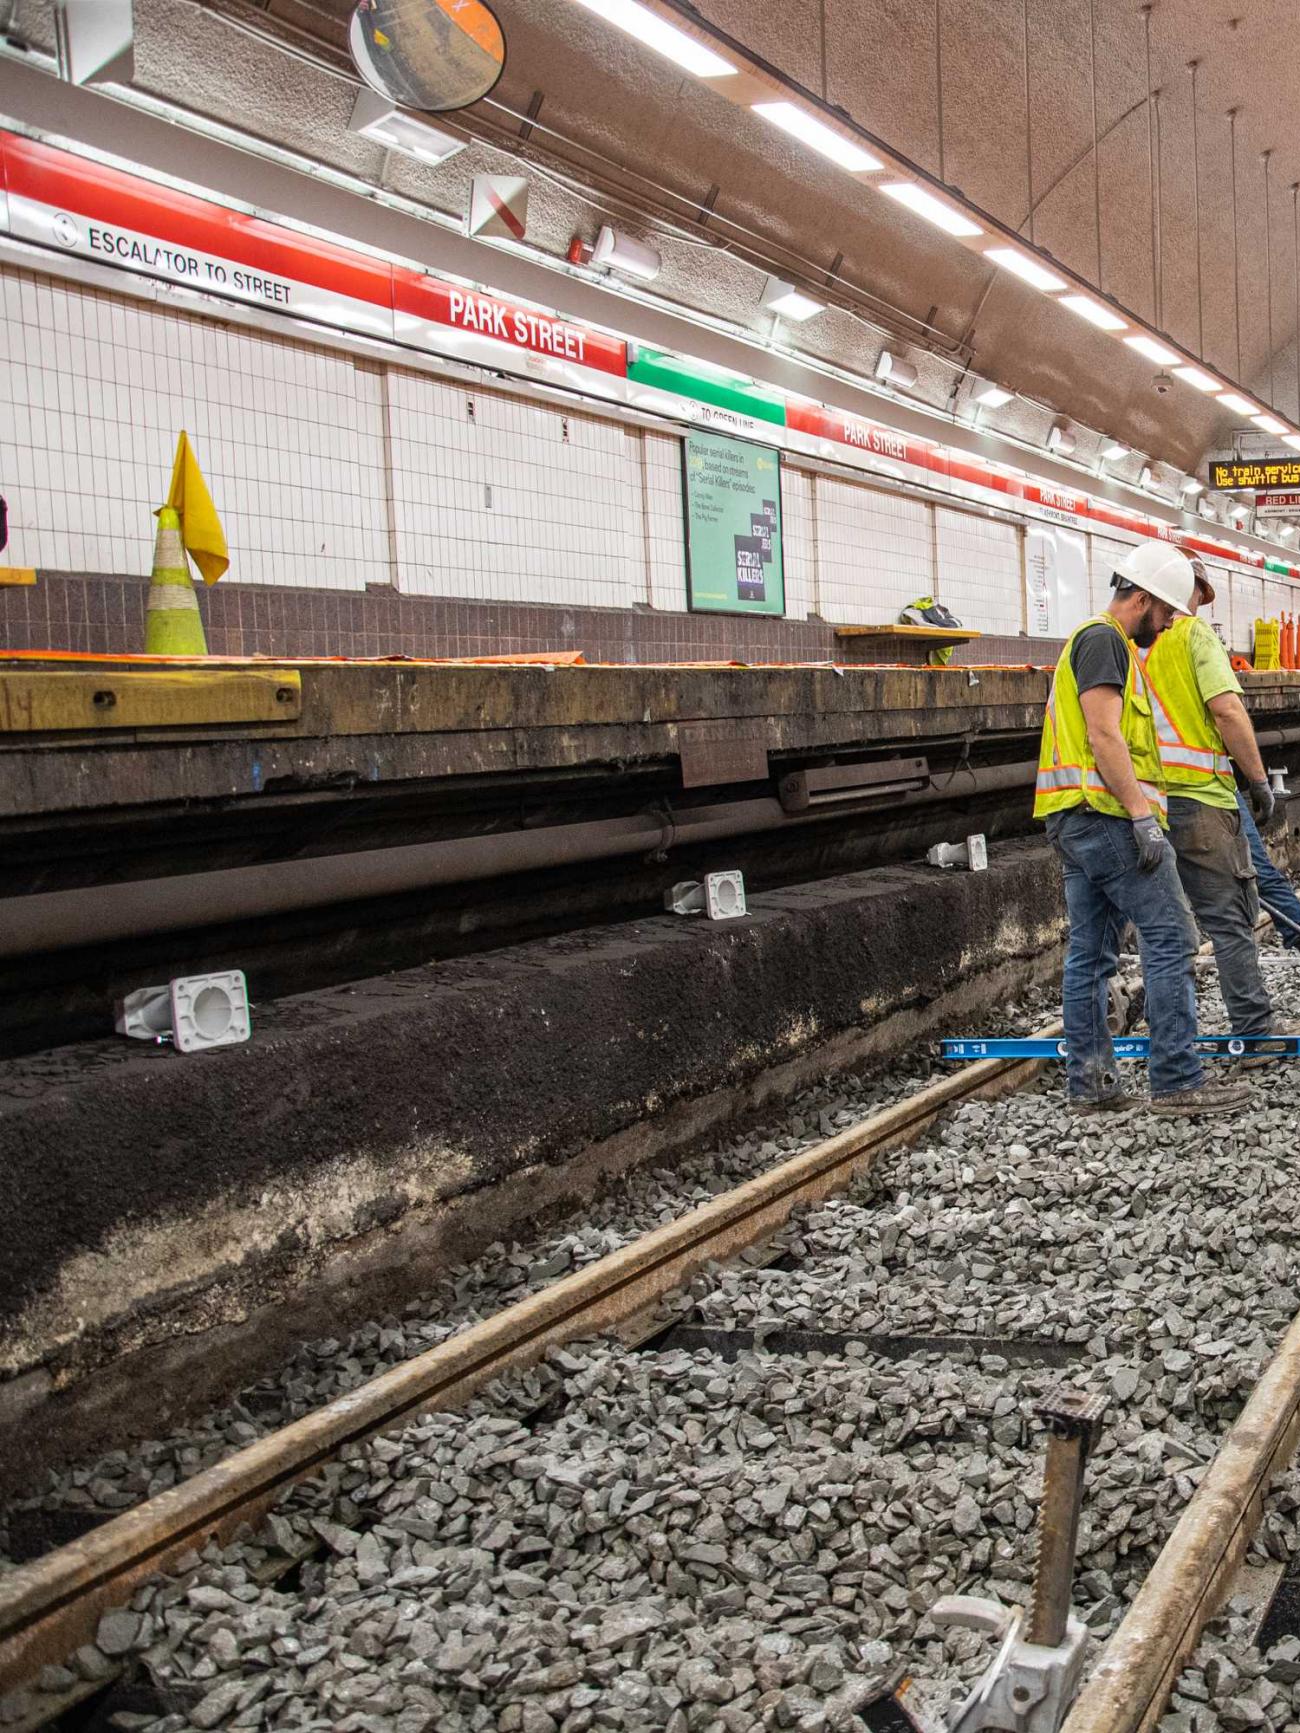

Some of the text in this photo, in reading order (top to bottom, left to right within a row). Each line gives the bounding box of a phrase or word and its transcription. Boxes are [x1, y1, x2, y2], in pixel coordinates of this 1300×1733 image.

[88, 227, 291, 304] ESCALATOR TO STREET
[450, 290, 586, 361] PARK STREET
[701, 407, 711, 421] TO
[844, 422, 908, 459] PARK STREET
[689, 441, 708, 459] Popular
[709, 447, 724, 459] serial
[704, 460, 722, 473] based
[1216, 467, 1228, 477] No
[1232, 466, 1261, 477] train
[1216, 473, 1299, 486] Use shuttle bus
[1265, 496, 1286, 505] RED
[737, 550, 760, 568] SERIAL
[737, 567, 764, 585] KILLERS
[1113, 1044, 1135, 1053] pire
